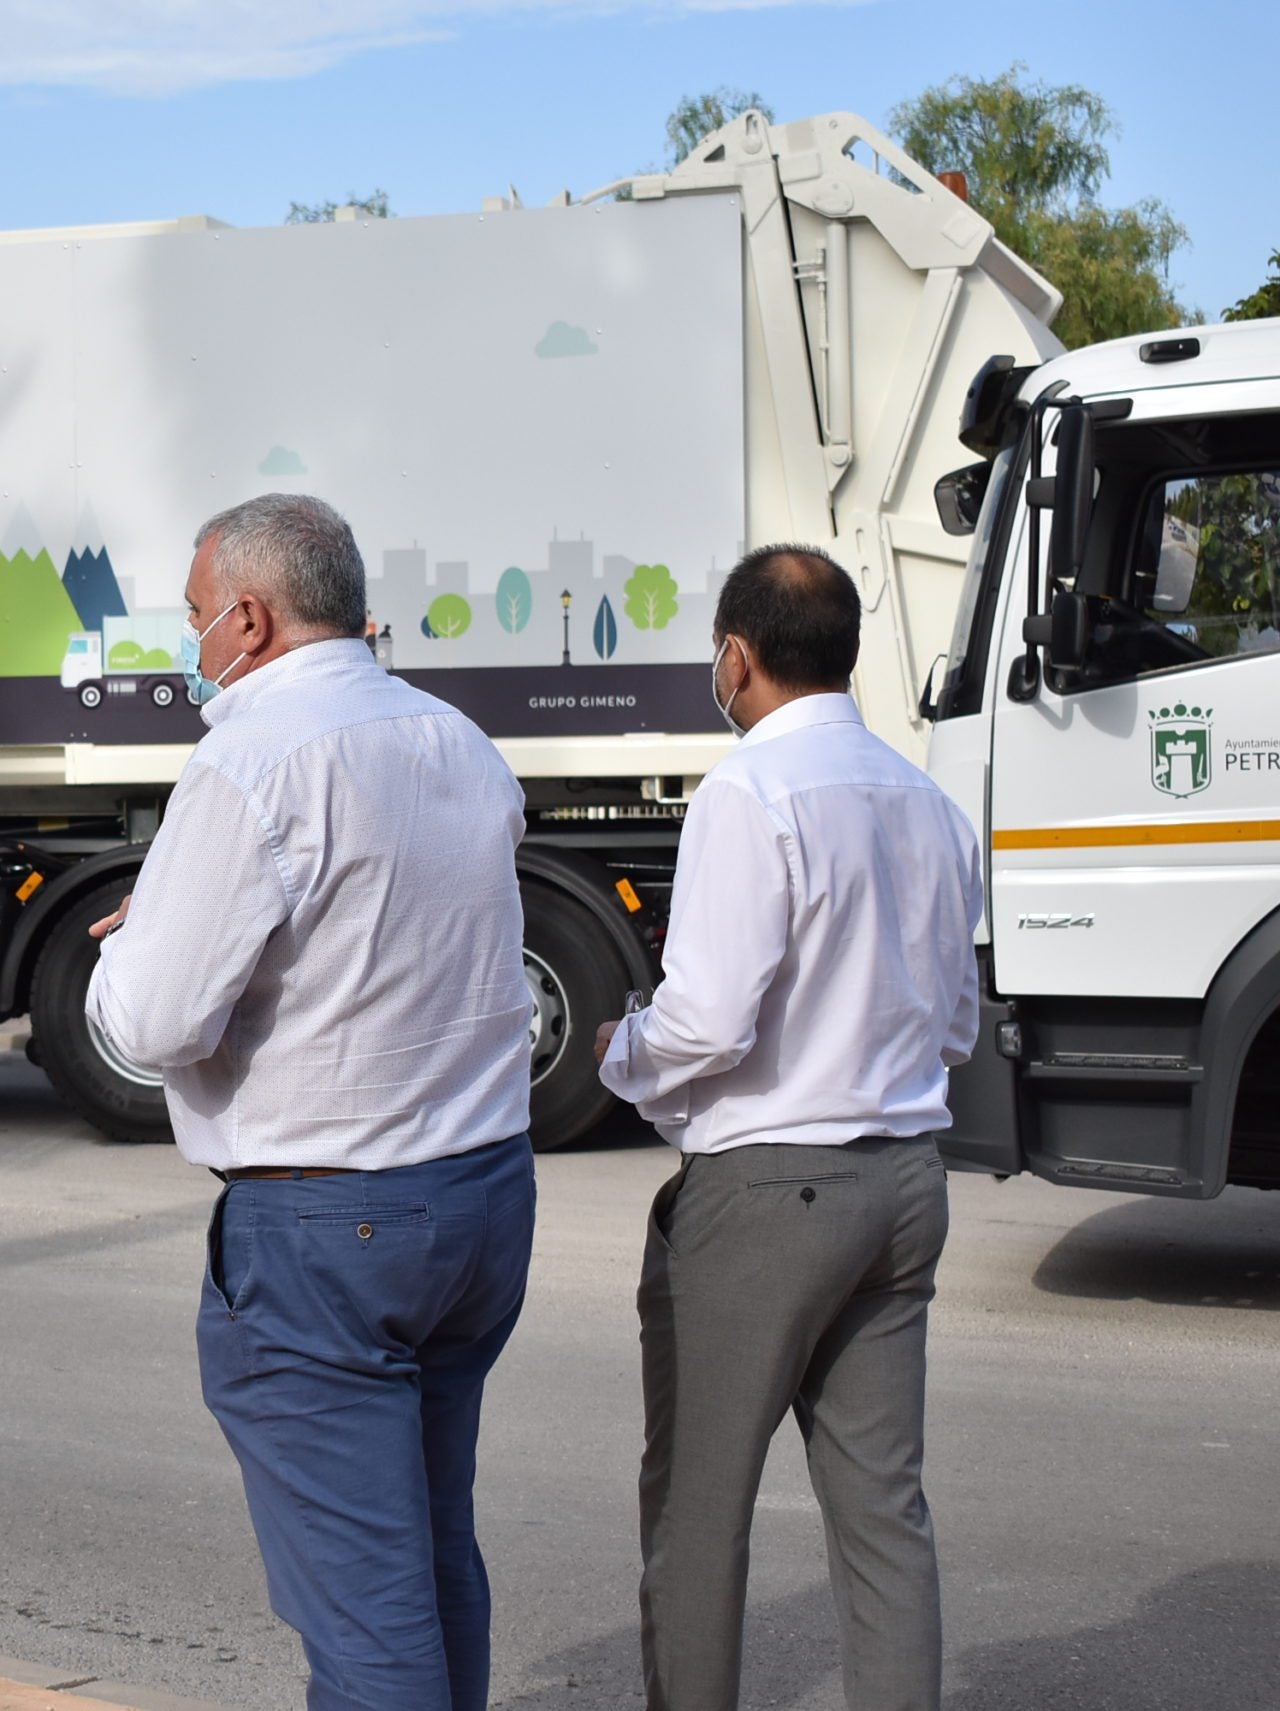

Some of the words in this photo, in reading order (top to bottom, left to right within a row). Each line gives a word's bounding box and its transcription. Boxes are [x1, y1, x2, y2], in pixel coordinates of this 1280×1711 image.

[528, 697, 576, 708] GRUPO
[580, 695, 636, 707] GIMENO
[1018, 912, 1096, 930] 1524
